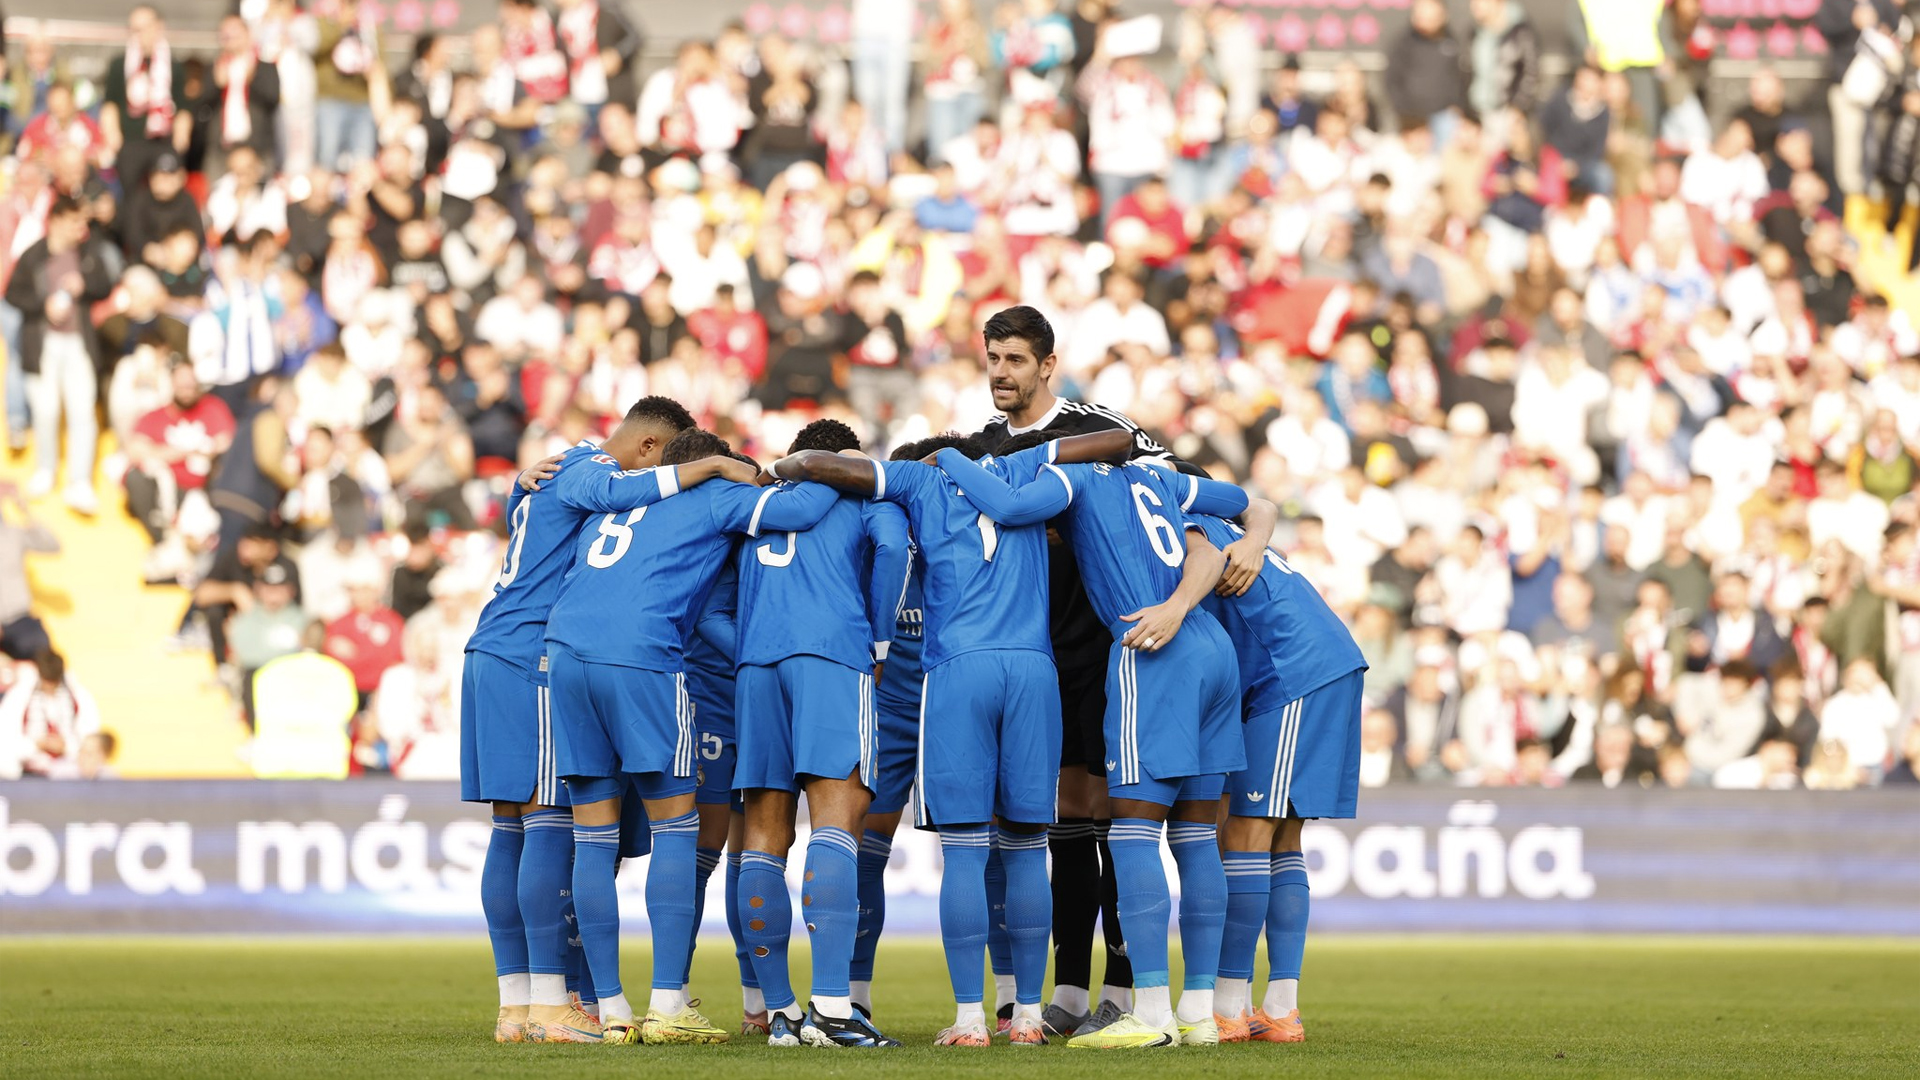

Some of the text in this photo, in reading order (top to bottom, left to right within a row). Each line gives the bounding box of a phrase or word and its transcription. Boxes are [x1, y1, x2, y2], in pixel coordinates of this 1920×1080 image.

[586, 505, 648, 569] 8
[1130, 481, 1184, 568] 6
[701, 732, 723, 761] 5
[237, 793, 486, 895] más
